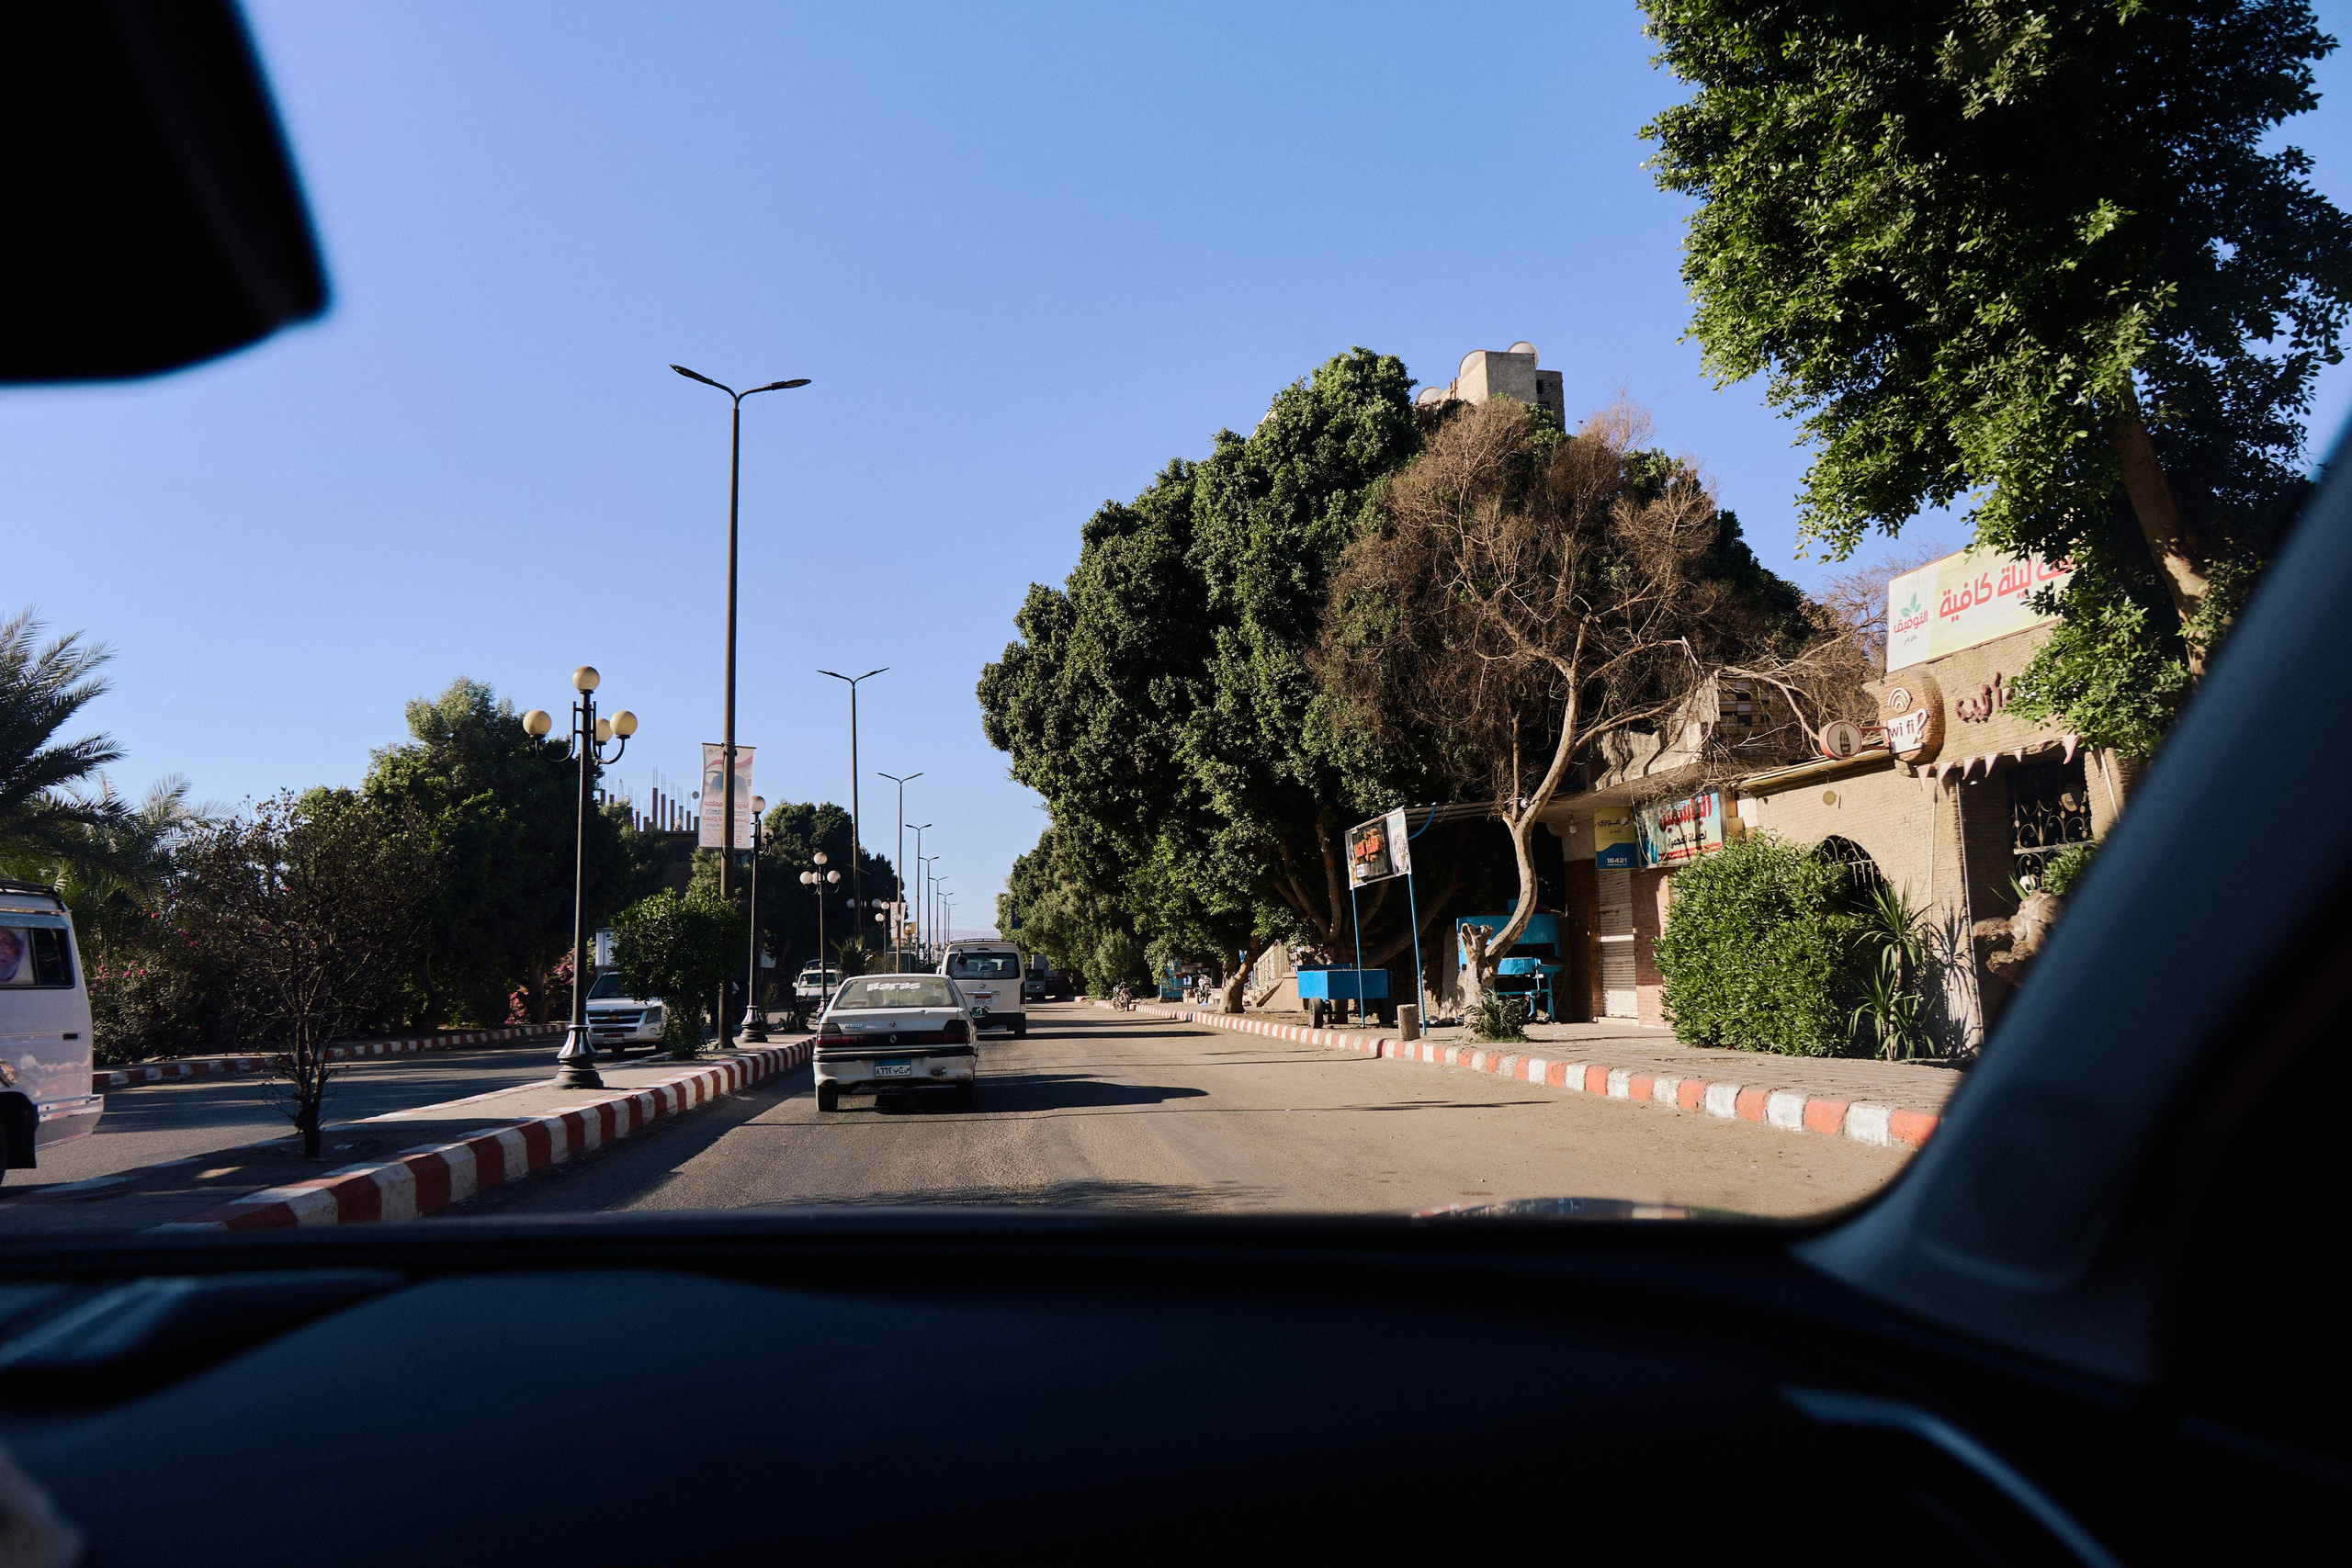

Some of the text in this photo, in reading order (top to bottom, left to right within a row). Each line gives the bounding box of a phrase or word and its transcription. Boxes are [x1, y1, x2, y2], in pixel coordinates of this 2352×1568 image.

[1997, 558, 2032, 599] ليلة
[1939, 571, 1993, 623] كافية
[1894, 610, 1928, 634] التوفيق
[1890, 719, 1915, 739] wi fi
[866, 982, 922, 992] Karas
